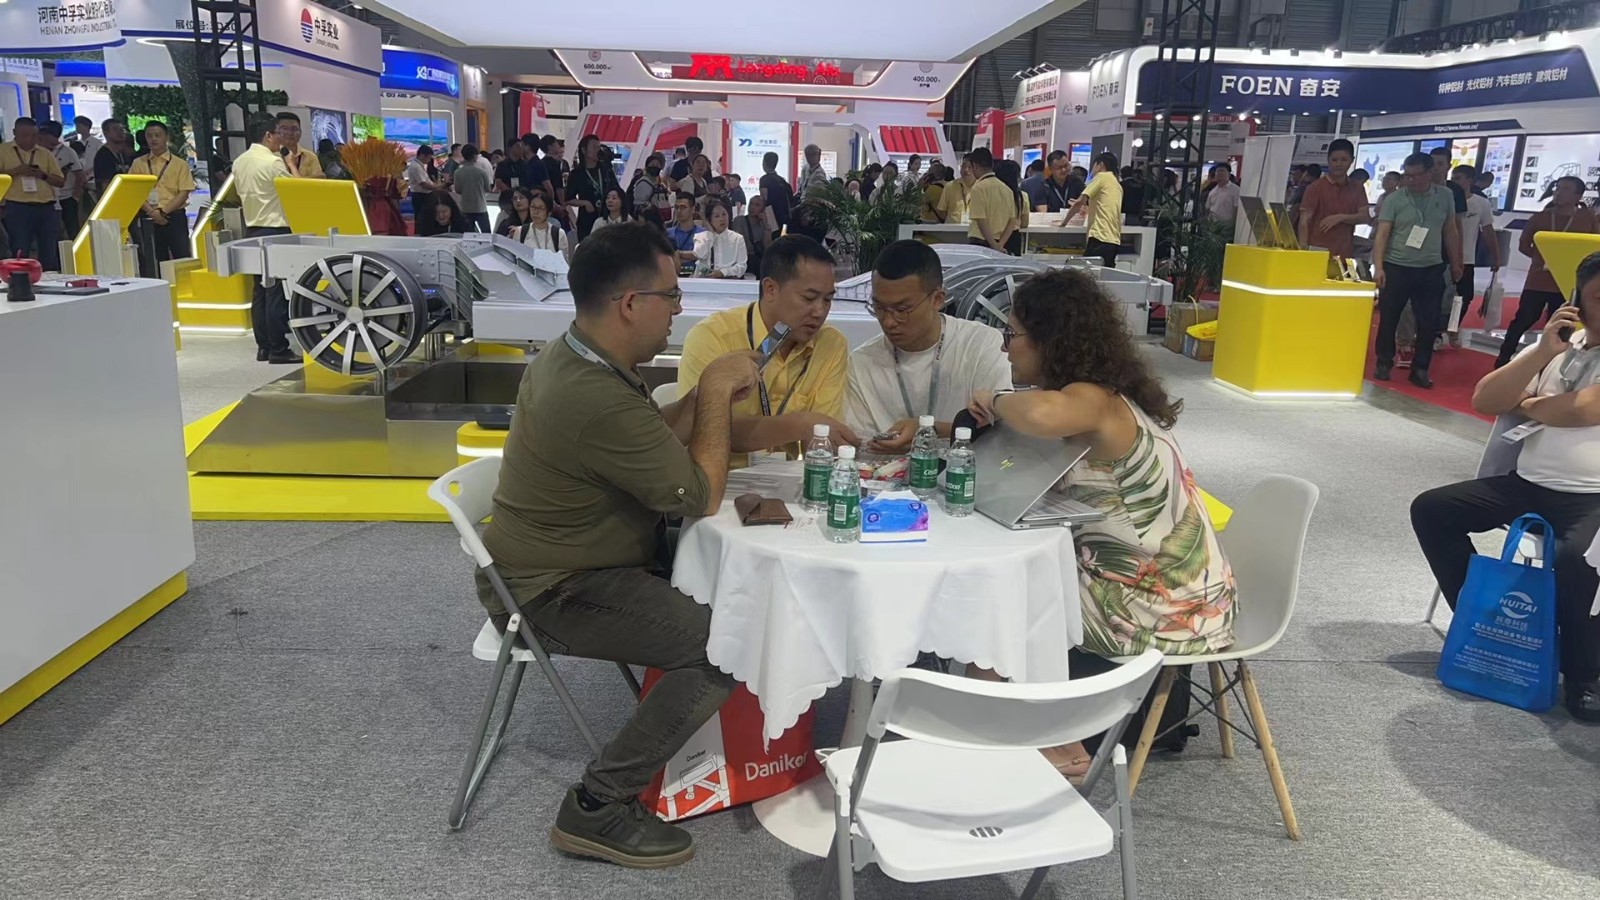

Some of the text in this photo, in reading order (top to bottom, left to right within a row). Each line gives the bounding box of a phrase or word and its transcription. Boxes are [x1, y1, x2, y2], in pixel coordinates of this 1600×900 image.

[40, 26, 63, 36] HENAN
[314, 16, 339, 41] 中孚实业
[1092, 82, 1109, 100] FOEN
[1220, 75, 1294, 96] FOEN
[1466, 76, 1494, 92] 光伏铝材
[1495, 71, 1533, 88] 汽车铝部件
[1499, 597, 1538, 613] HUITAI
[745, 752, 807, 781] Danikor
